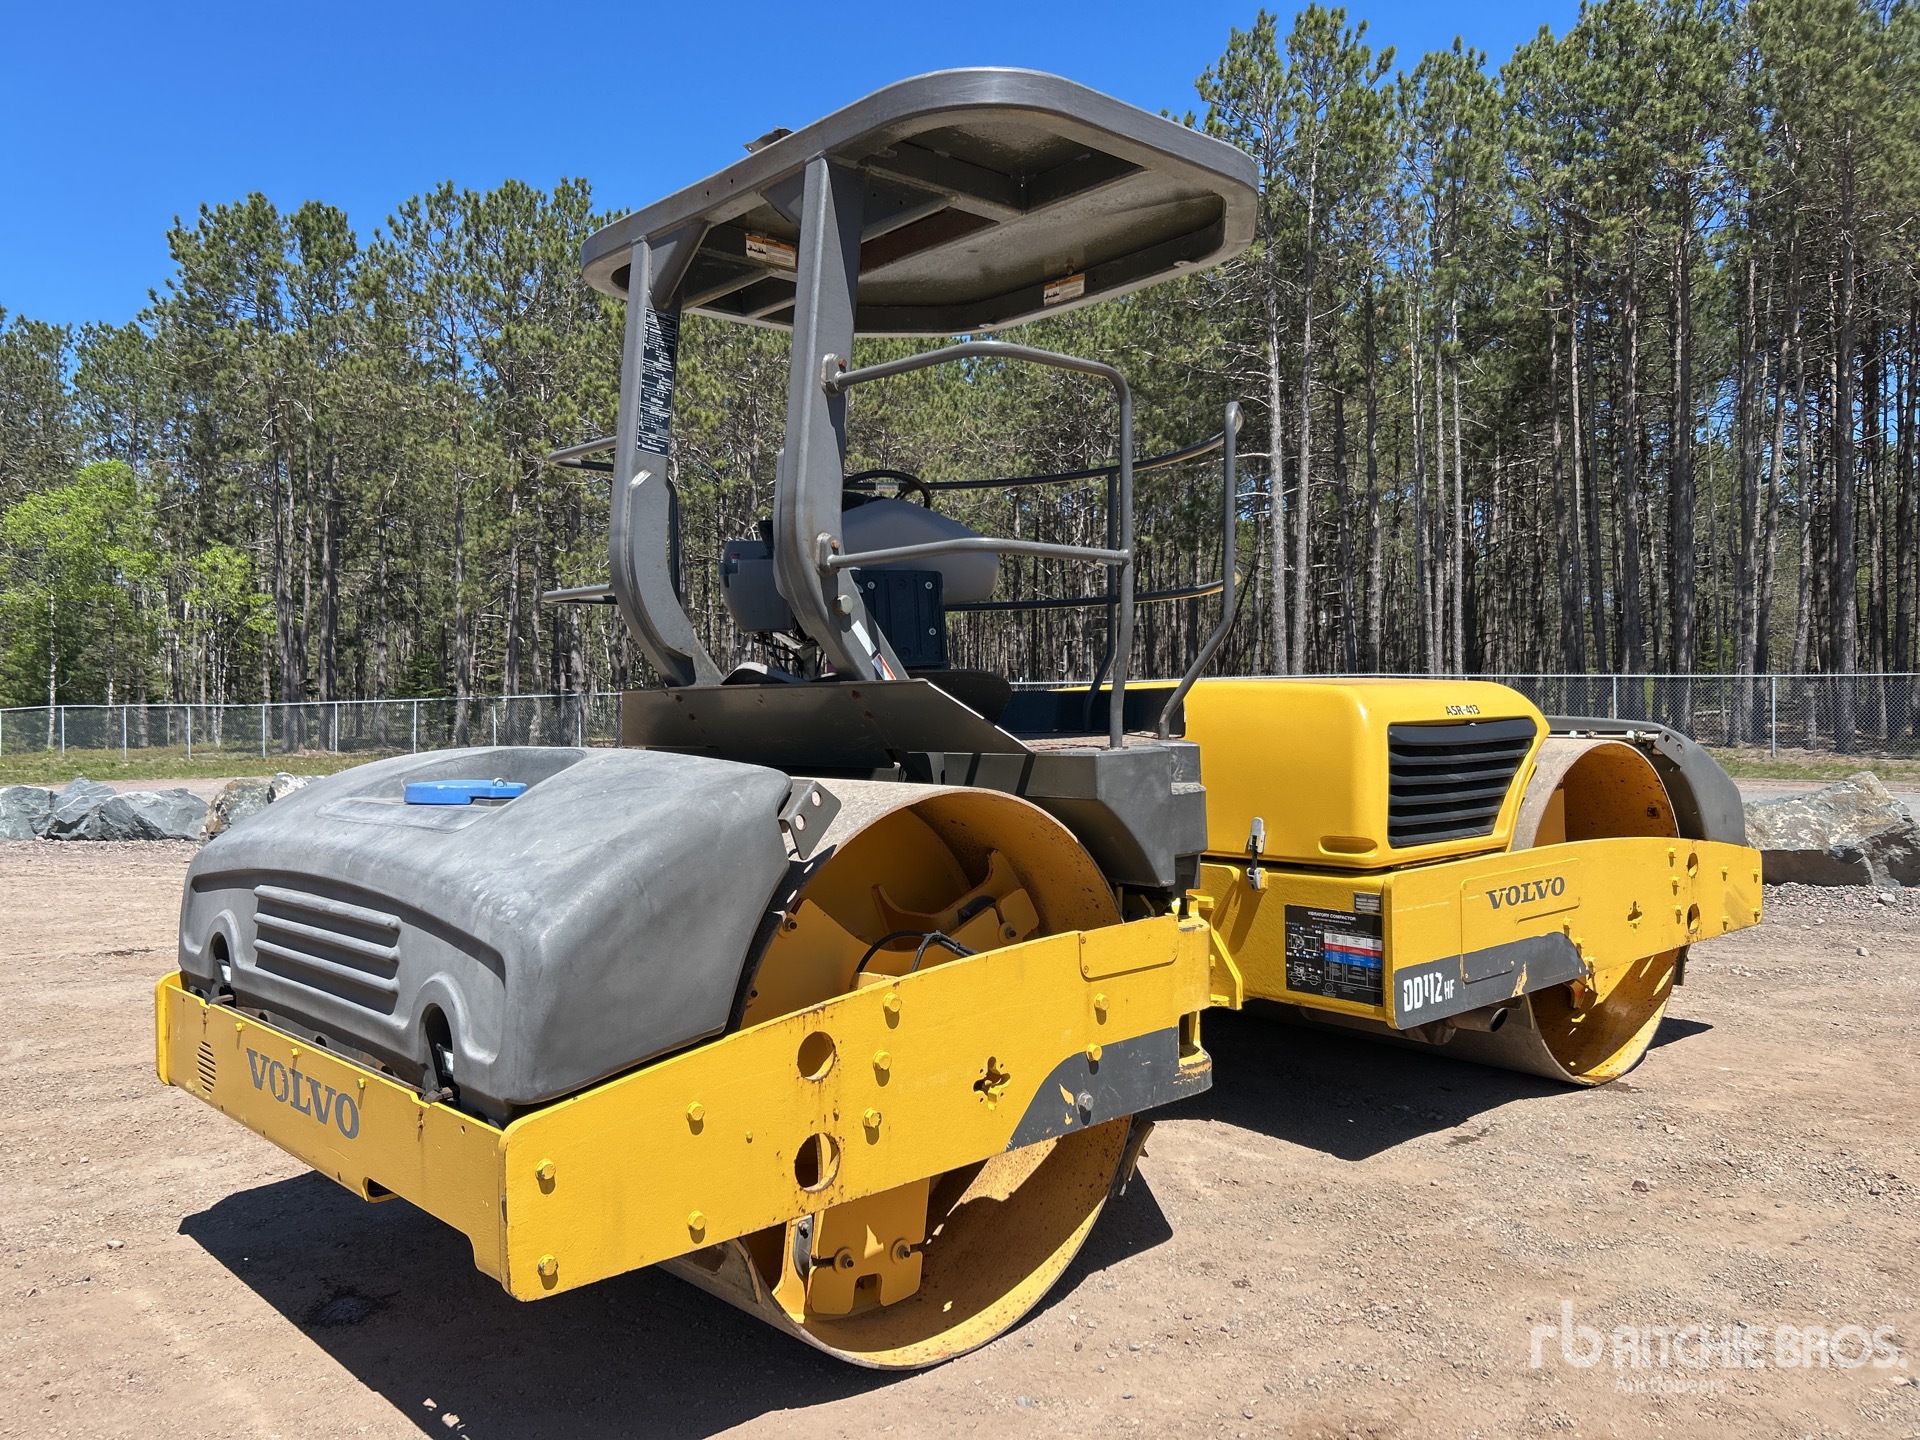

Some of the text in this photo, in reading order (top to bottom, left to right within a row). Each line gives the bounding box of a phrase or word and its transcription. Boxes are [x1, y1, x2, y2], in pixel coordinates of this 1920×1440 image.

[1485, 876, 1565, 910] VOLVO
[1330, 913, 1357, 921] COMPACTOR
[1444, 978, 1455, 1000] HF
[246, 1047, 360, 1140] VOLVO
